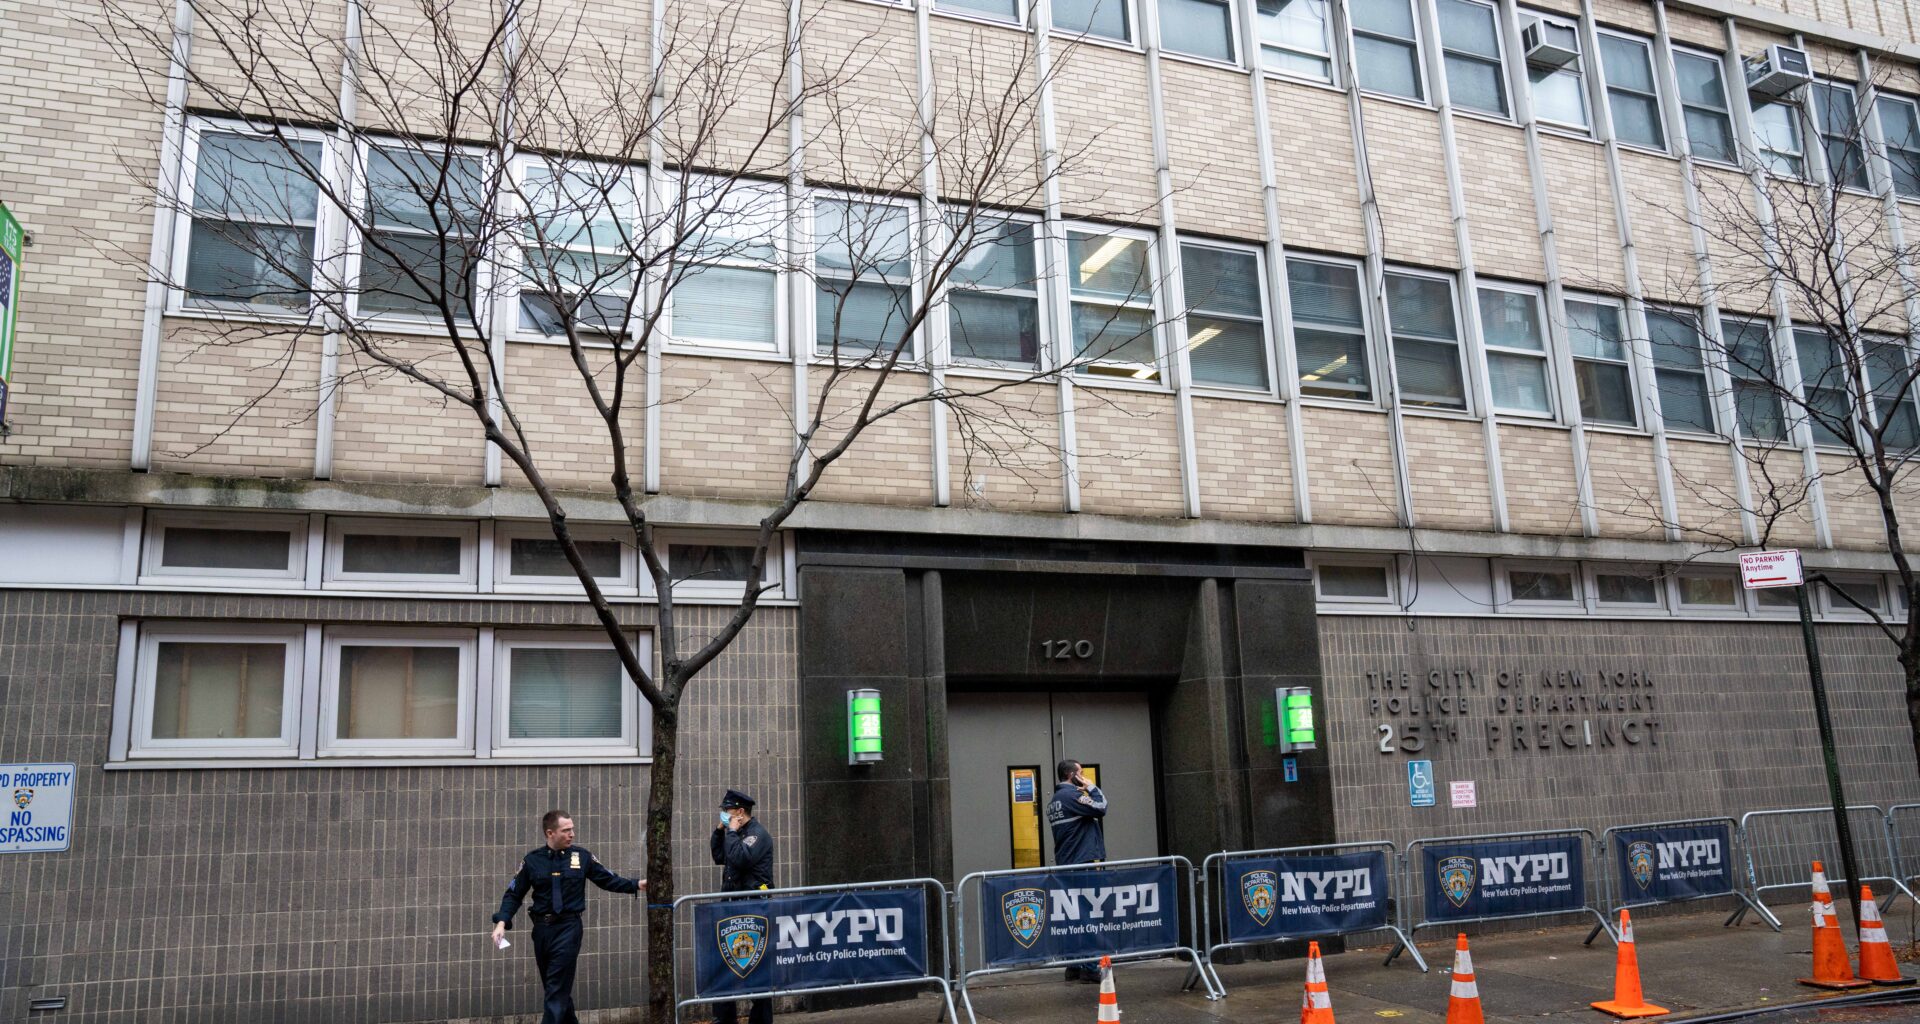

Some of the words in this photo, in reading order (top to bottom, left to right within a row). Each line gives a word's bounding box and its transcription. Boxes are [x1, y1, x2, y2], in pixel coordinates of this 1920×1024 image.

[5, 218, 17, 246] 175
[1755, 555, 1785, 563] PARKING
[1745, 564, 1773, 572] Anytime
[1042, 639, 1094, 659] 120
[1366, 670, 1409, 690] THE
[1428, 668, 1477, 689] CITY
[1497, 669, 1523, 688] OF
[1541, 669, 1584, 688] NEW
[1599, 669, 1654, 688] YORK
[1369, 695, 1468, 715] POLICE
[1496, 694, 1656, 713] DEPARTMENT
[1378, 721, 1458, 754] 25TH
[1485, 718, 1660, 751] PRECINCT
[13, 772, 71, 787] PROPERTY
[10, 811, 32, 827] NO
[0, 826, 66, 843] SPASSING
[1656, 838, 1721, 869] NYPD
[1480, 852, 1569, 886] NYPD
[1679, 871, 1687, 879] City
[1280, 868, 1372, 902] NYPD
[1482, 889, 1495, 898] New
[1495, 888, 1509, 896] York
[1509, 887, 1520, 896] City
[1521, 886, 1538, 894] Police
[1538, 883, 1571, 894] Department
[1005, 896, 1043, 909] DEPARTMENT
[1013, 890, 1035, 898] POLICE
[1050, 883, 1160, 921] NYPD
[1282, 906, 1297, 915] New
[1298, 905, 1311, 914] York
[1311, 904, 1321, 914] City
[1321, 904, 1340, 912] Police
[1340, 901, 1376, 912] Department
[720, 923, 766, 937] DEPARTMENT
[730, 917, 755, 926] POLICE
[775, 908, 903, 950] NYPD
[1050, 926, 1068, 935] New
[1068, 925, 1085, 934] York
[1085, 924, 1098, 934] City
[1099, 922, 1121, 932] Police
[1122, 918, 1162, 931] Department
[721, 942, 731, 957] CITY
[776, 955, 795, 965] New
[796, 953, 814, 963] York
[815, 951, 832, 962] City
[833, 949, 857, 959] Police
[858, 946, 906, 958] Department
